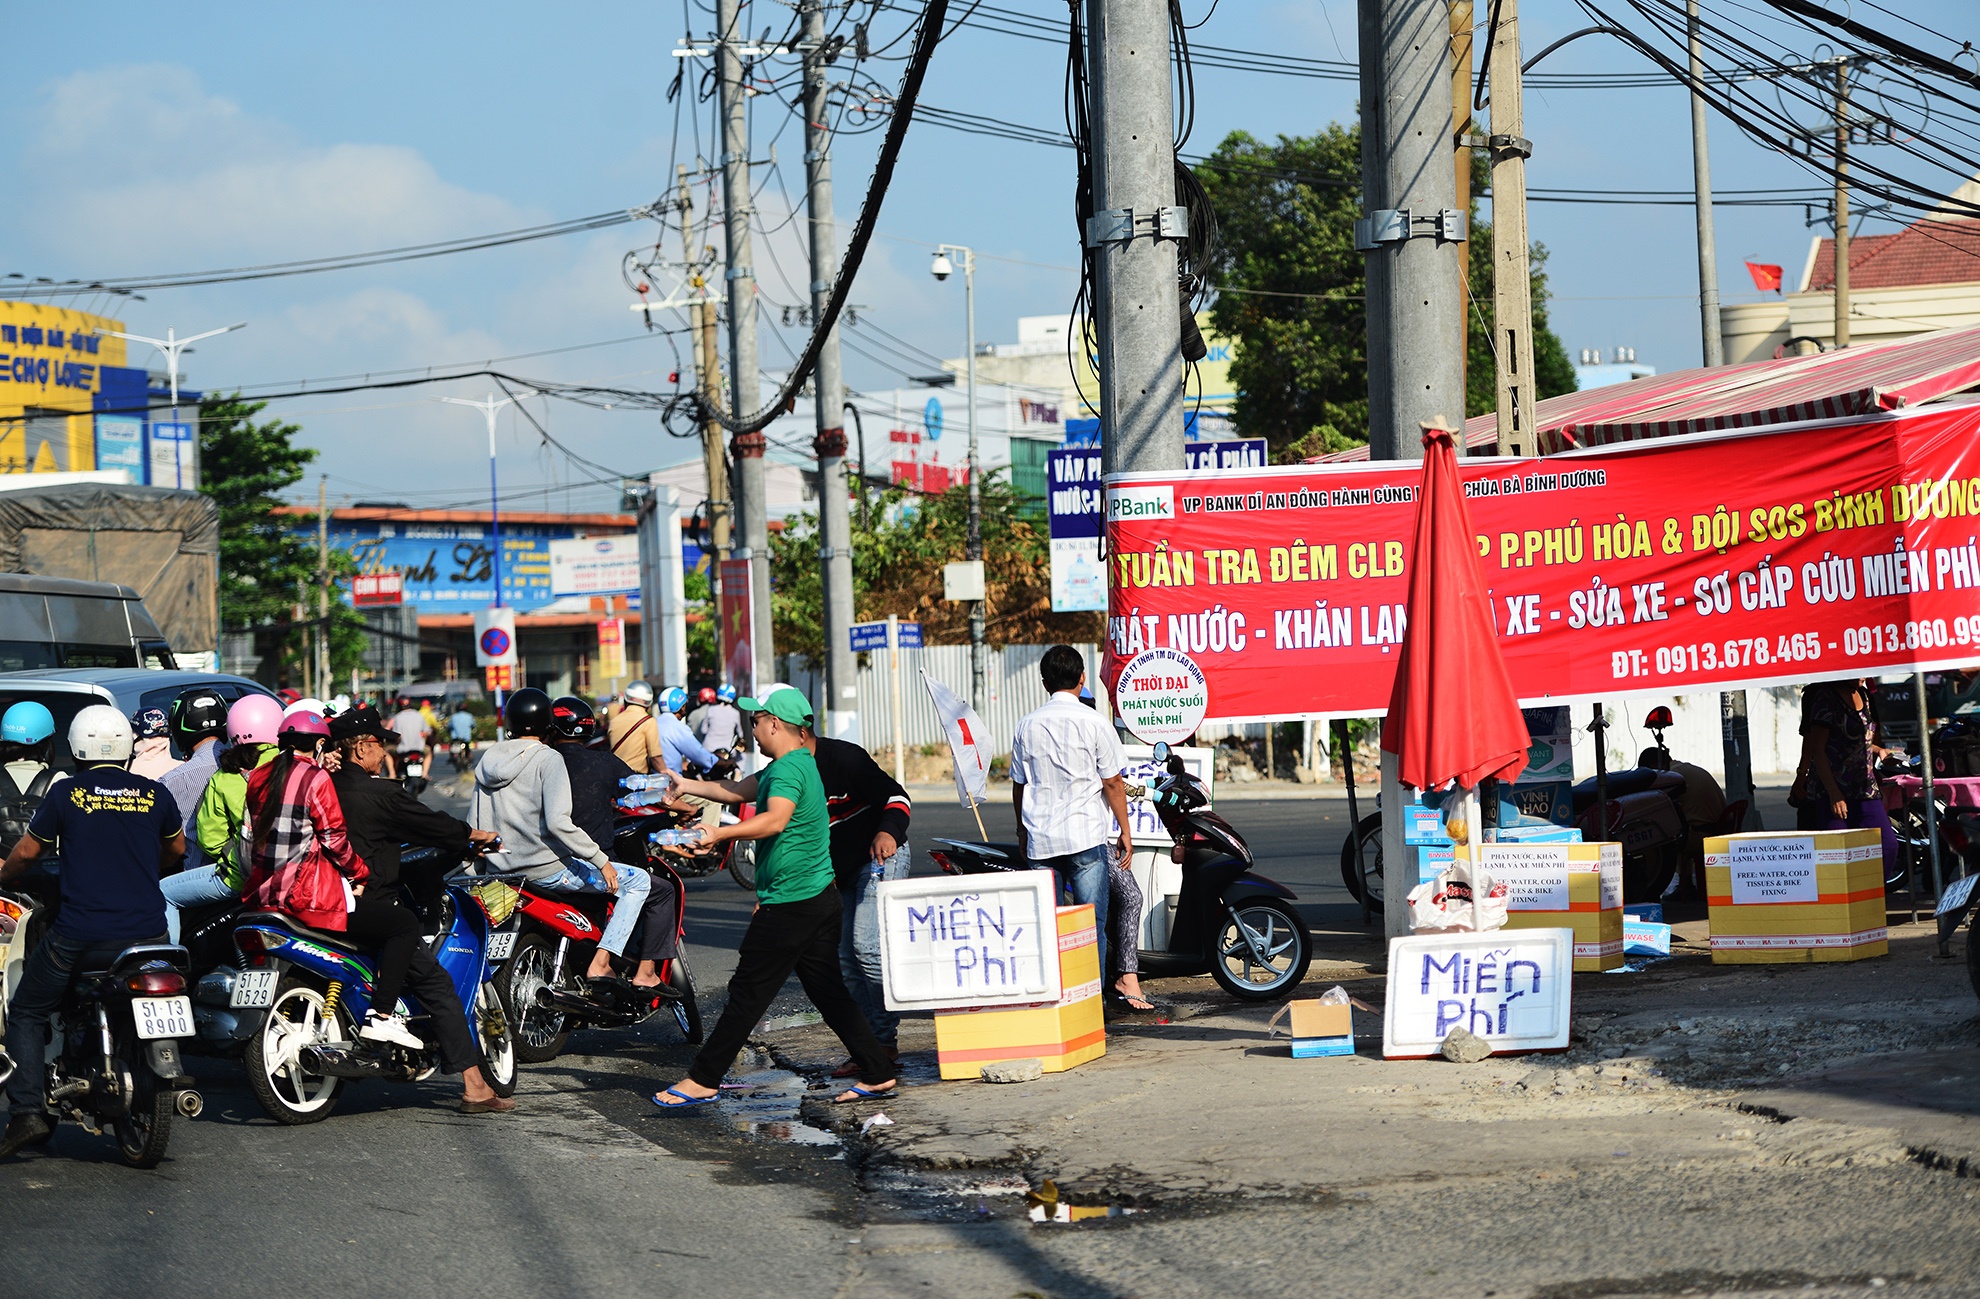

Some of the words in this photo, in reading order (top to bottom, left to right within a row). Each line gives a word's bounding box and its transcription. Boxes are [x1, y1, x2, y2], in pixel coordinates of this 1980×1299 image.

[1503, 472, 1521, 494] BÀ
[1525, 473, 1557, 493] BÌNH
[1561, 469, 1606, 488] DƯƠNG
[1183, 497, 1202, 514] VP
[1205, 494, 1244, 512] BANK
[1248, 490, 1262, 510] DĨ
[1266, 493, 1285, 509] AN
[1289, 487, 1328, 508] ĐỒNG
[1332, 485, 1370, 506] HÀNH
[1374, 482, 1411, 504] CÙNG
[1500, 518, 1584, 569] P.PHÚ
[1592, 513, 1653, 561] HÒA
[1661, 516, 1683, 555] &
[1691, 504, 1741, 555] ĐỘI
[1748, 503, 1807, 543] SOS
[1814, 489, 1885, 533] BÌNH
[1891, 476, 1980, 523] DƯƠNG
[1118, 539, 1195, 589] TUẦN
[1203, 549, 1262, 586] TRA
[1269, 538, 1338, 583] ĐÊM
[1347, 540, 1405, 580] CLB
[1505, 594, 1541, 637] XE
[1549, 610, 1561, 621] -
[1567, 575, 1626, 631] SỬA
[1631, 581, 1668, 623] XE
[1674, 597, 1685, 607] -
[1693, 570, 1733, 616] SƠ
[1737, 554, 1795, 612] CẤP
[1801, 551, 1856, 605] CỨU
[1862, 536, 1930, 598] MIỄN
[1935, 535, 1980, 591] PHÍ
[1109, 607, 1160, 655] PHÁT
[1168, 604, 1247, 654] NƯỚC
[1255, 628, 1267, 639] -
[1274, 599, 1353, 650] KHĂN
[1611, 649, 1649, 679] ĐT:
[1655, 631, 1822, 676] 0913.678.465
[1828, 642, 1837, 650] -
[1117, 671, 1133, 694] CÔNG
[1129, 662, 1138, 673] TY
[1136, 652, 1155, 667] TNHH
[1155, 650, 1166, 659] TM
[1176, 654, 1190, 667] LAO
[1188, 663, 1205, 685] ĐỘNG
[1132, 674, 1162, 692] THỜI
[1166, 675, 1189, 693] ĐẠI
[1122, 697, 1148, 710] PHÁT
[1149, 696, 1178, 709] NƯỚC
[1180, 692, 1204, 708] SUỐI
[1887, 692, 1910, 701] JAC
[1137, 711, 1163, 726] MIỄN
[1165, 711, 1182, 725] PHÍ
[1523, 707, 1553, 724] UAFINA
[1627, 829, 1654, 844] CSGT
[1490, 851, 1511, 860] PHÁT
[1738, 844, 1757, 853] PHÁT
[1508, 861, 1519, 869] VÁ
[1552, 860, 1565, 869] PHÍ
[1755, 854, 1766, 862] VÁ
[1767, 854, 1777, 862] XE
[1798, 852, 1812, 861] PHÍ
[1510, 878, 1540, 886] WATER,
[1540, 878, 1562, 886] COLD
[1737, 872, 1758, 880] FREE:
[1759, 871, 1787, 879] WATER,
[1788, 870, 1810, 878] COLD
[1527, 887, 1533, 895] &
[1535, 887, 1554, 895] BIKE
[1746, 880, 1775, 888] TISSUES
[1784, 879, 1802, 887] BIKE
[1512, 896, 1539, 904] FIXING
[1761, 888, 1787, 897] FIXING
[488, 933, 512, 946] 7-L9
[1623, 933, 1655, 942] IWASE
[447, 946, 475, 955] HONDA
[236, 989, 268, 1005] 0529
[145, 1017, 187, 1035] 8900
